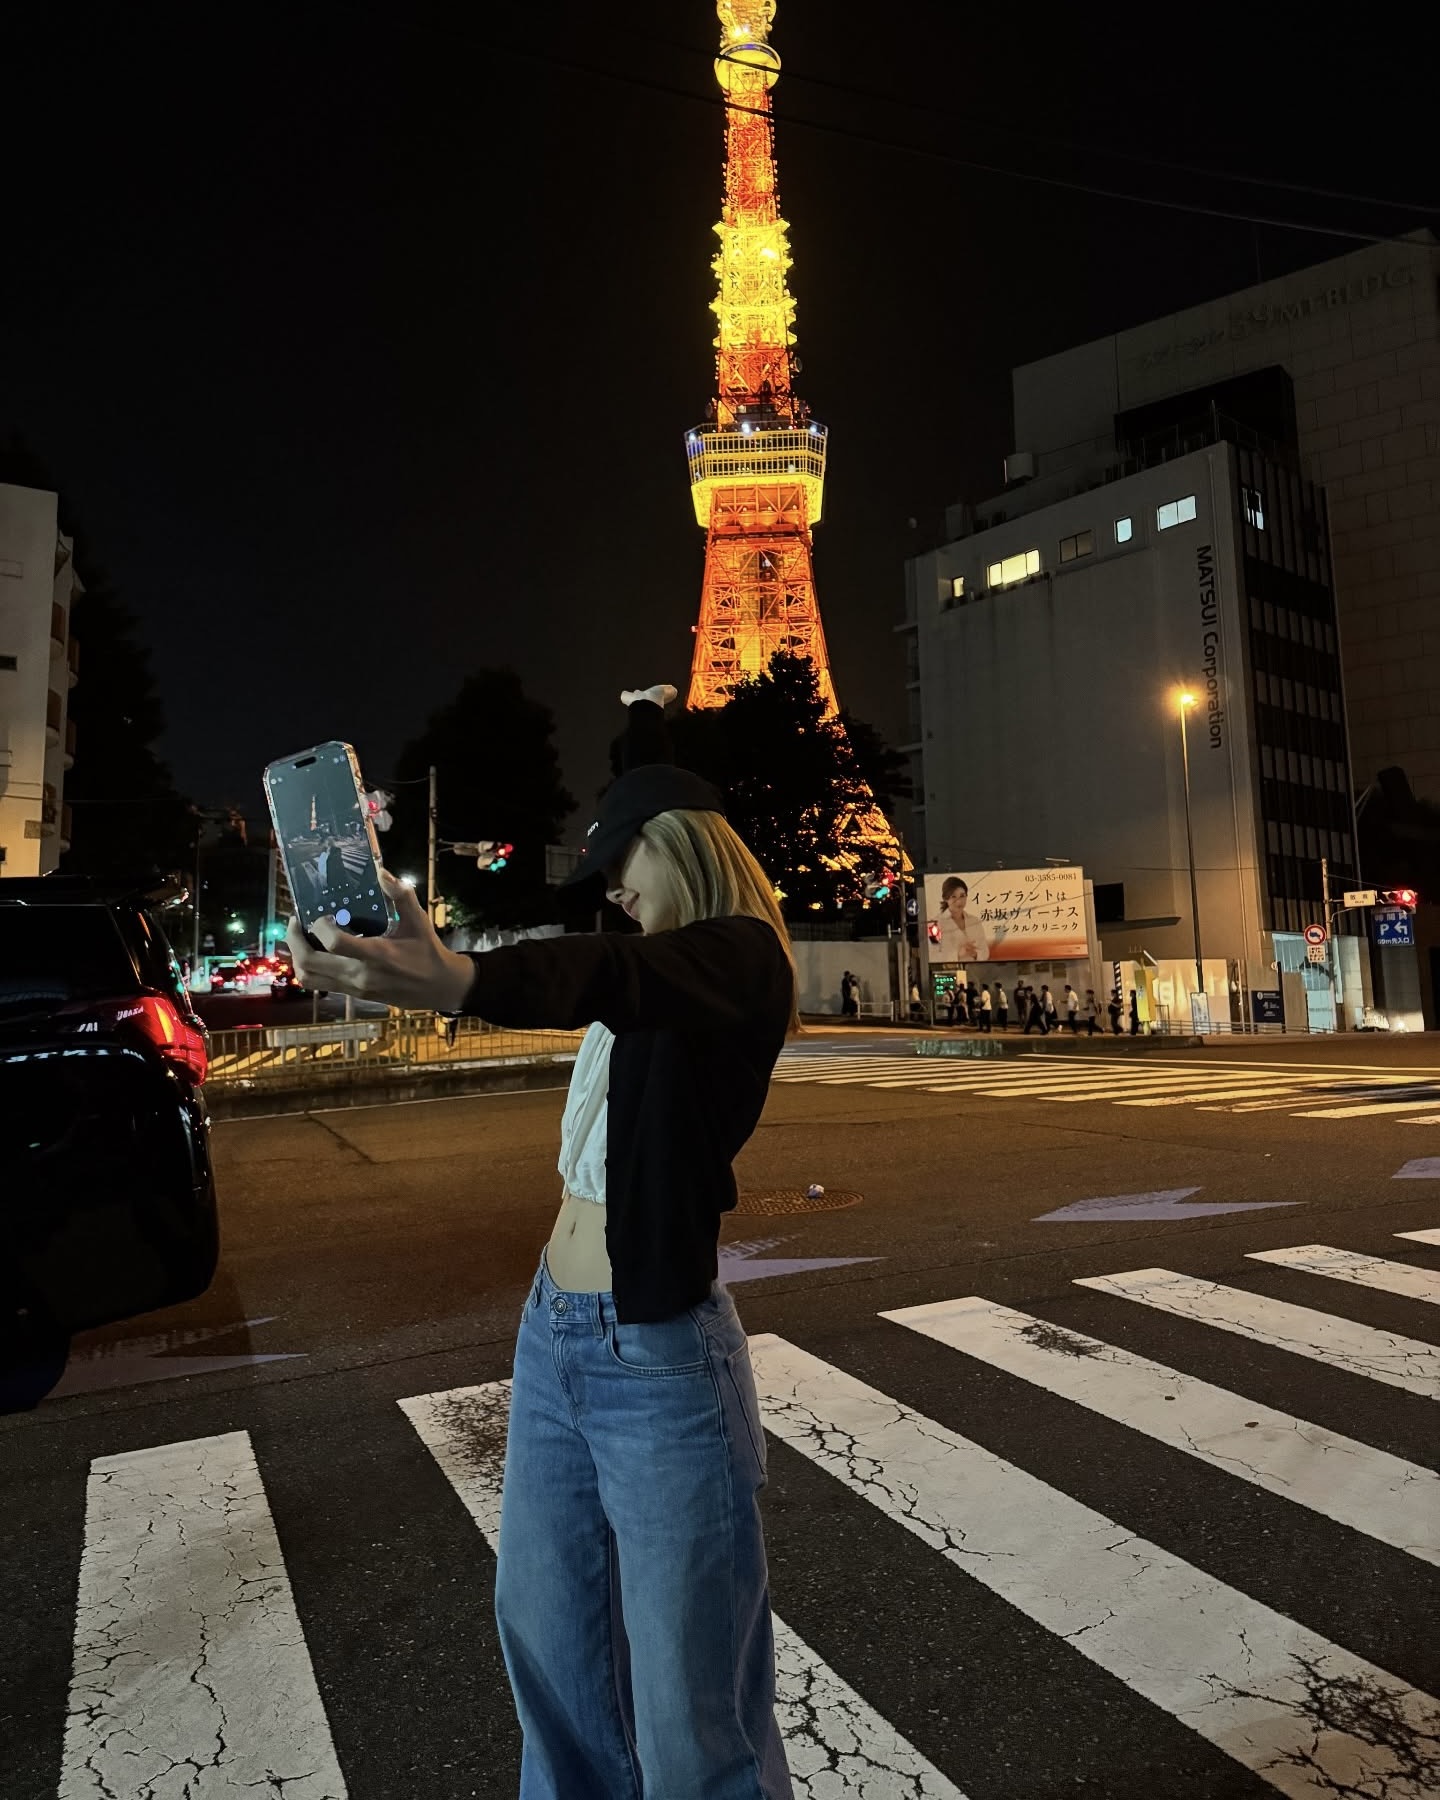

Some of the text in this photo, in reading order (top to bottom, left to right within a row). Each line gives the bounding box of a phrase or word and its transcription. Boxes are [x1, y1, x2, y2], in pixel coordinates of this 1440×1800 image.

[1197, 545, 1223, 750] MATSUI Corporation
[1025, 872, 1077, 883] 03-3585-0081
[972, 889, 1067, 905] インプラントは
[980, 906, 1079, 922] 赤坂ヴィーナス
[992, 923, 1079, 934] デンタルクリニック
[1380, 923, 1390, 936] P
